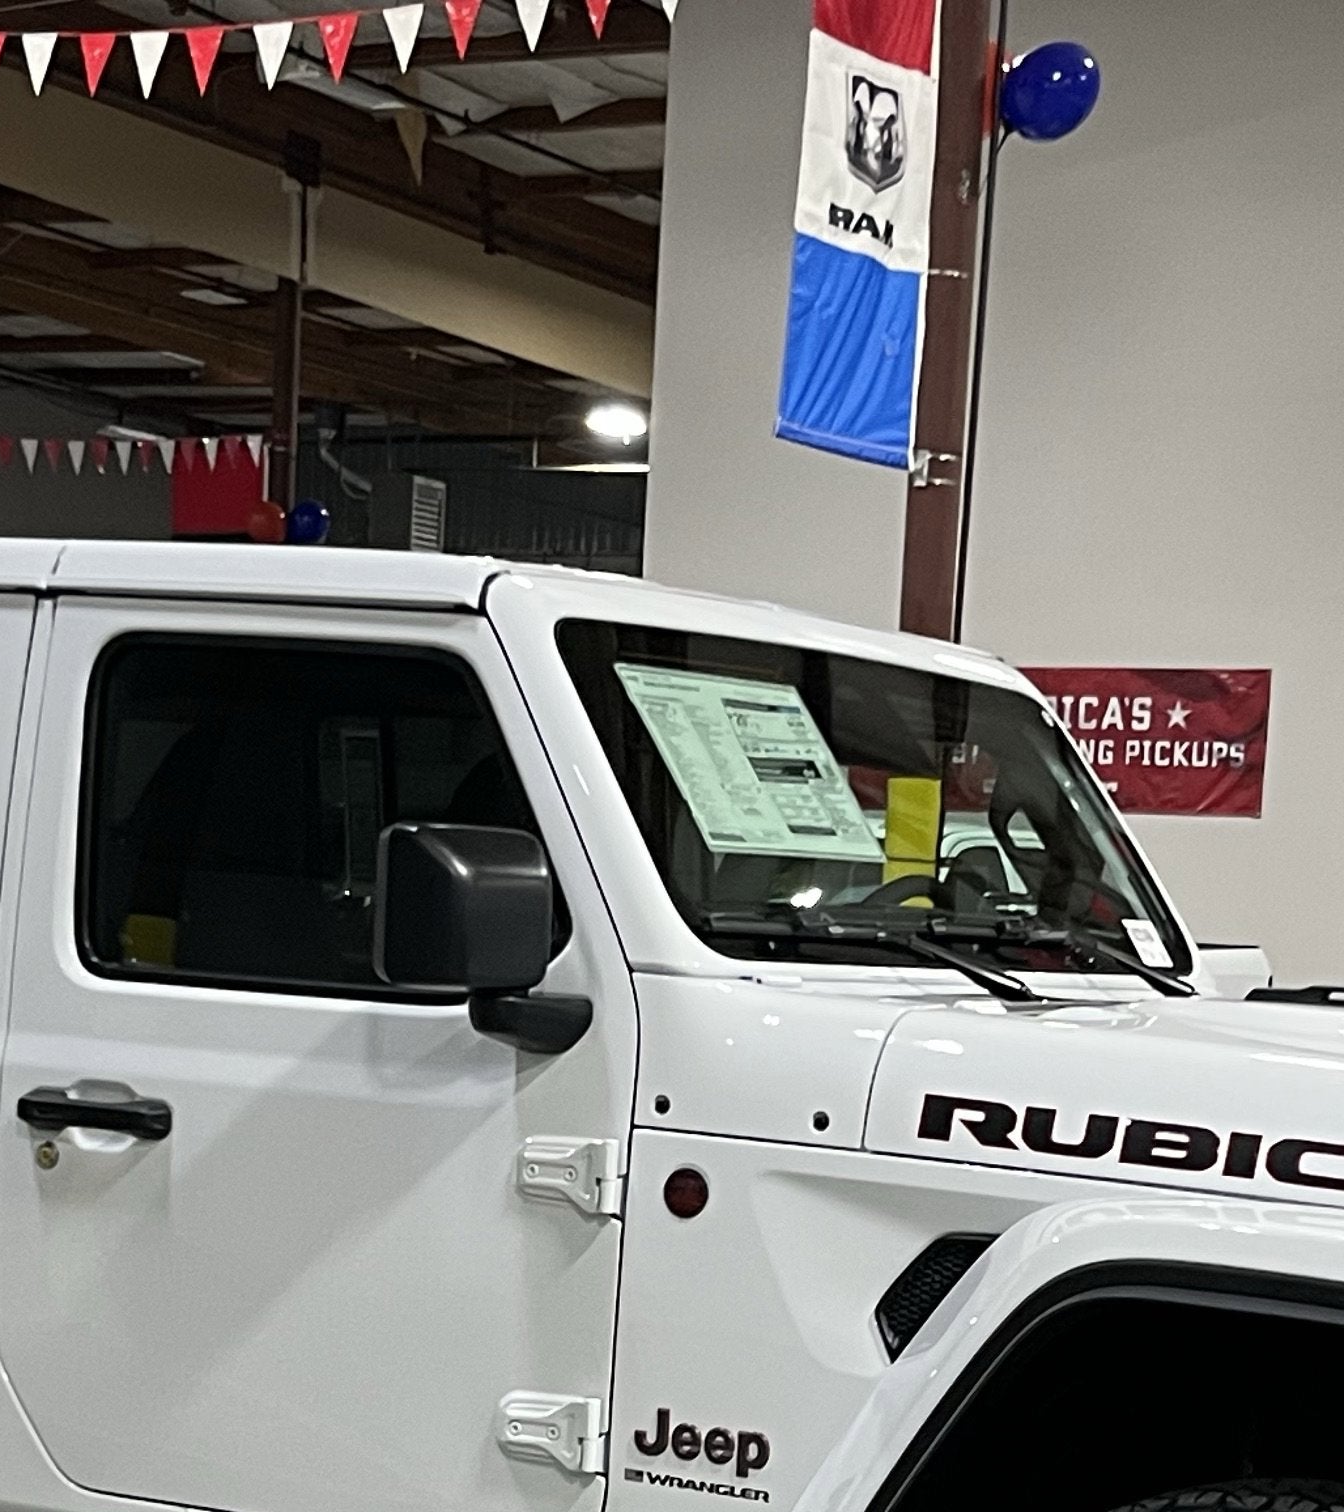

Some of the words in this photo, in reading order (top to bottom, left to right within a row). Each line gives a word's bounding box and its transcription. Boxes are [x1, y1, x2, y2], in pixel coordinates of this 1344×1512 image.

[1079, 739, 1115, 766] NG
[1125, 739, 1245, 769] PICKUPS
[633, 1407, 771, 1479] Jeep
[645, 1471, 770, 1503] WRANGLER
